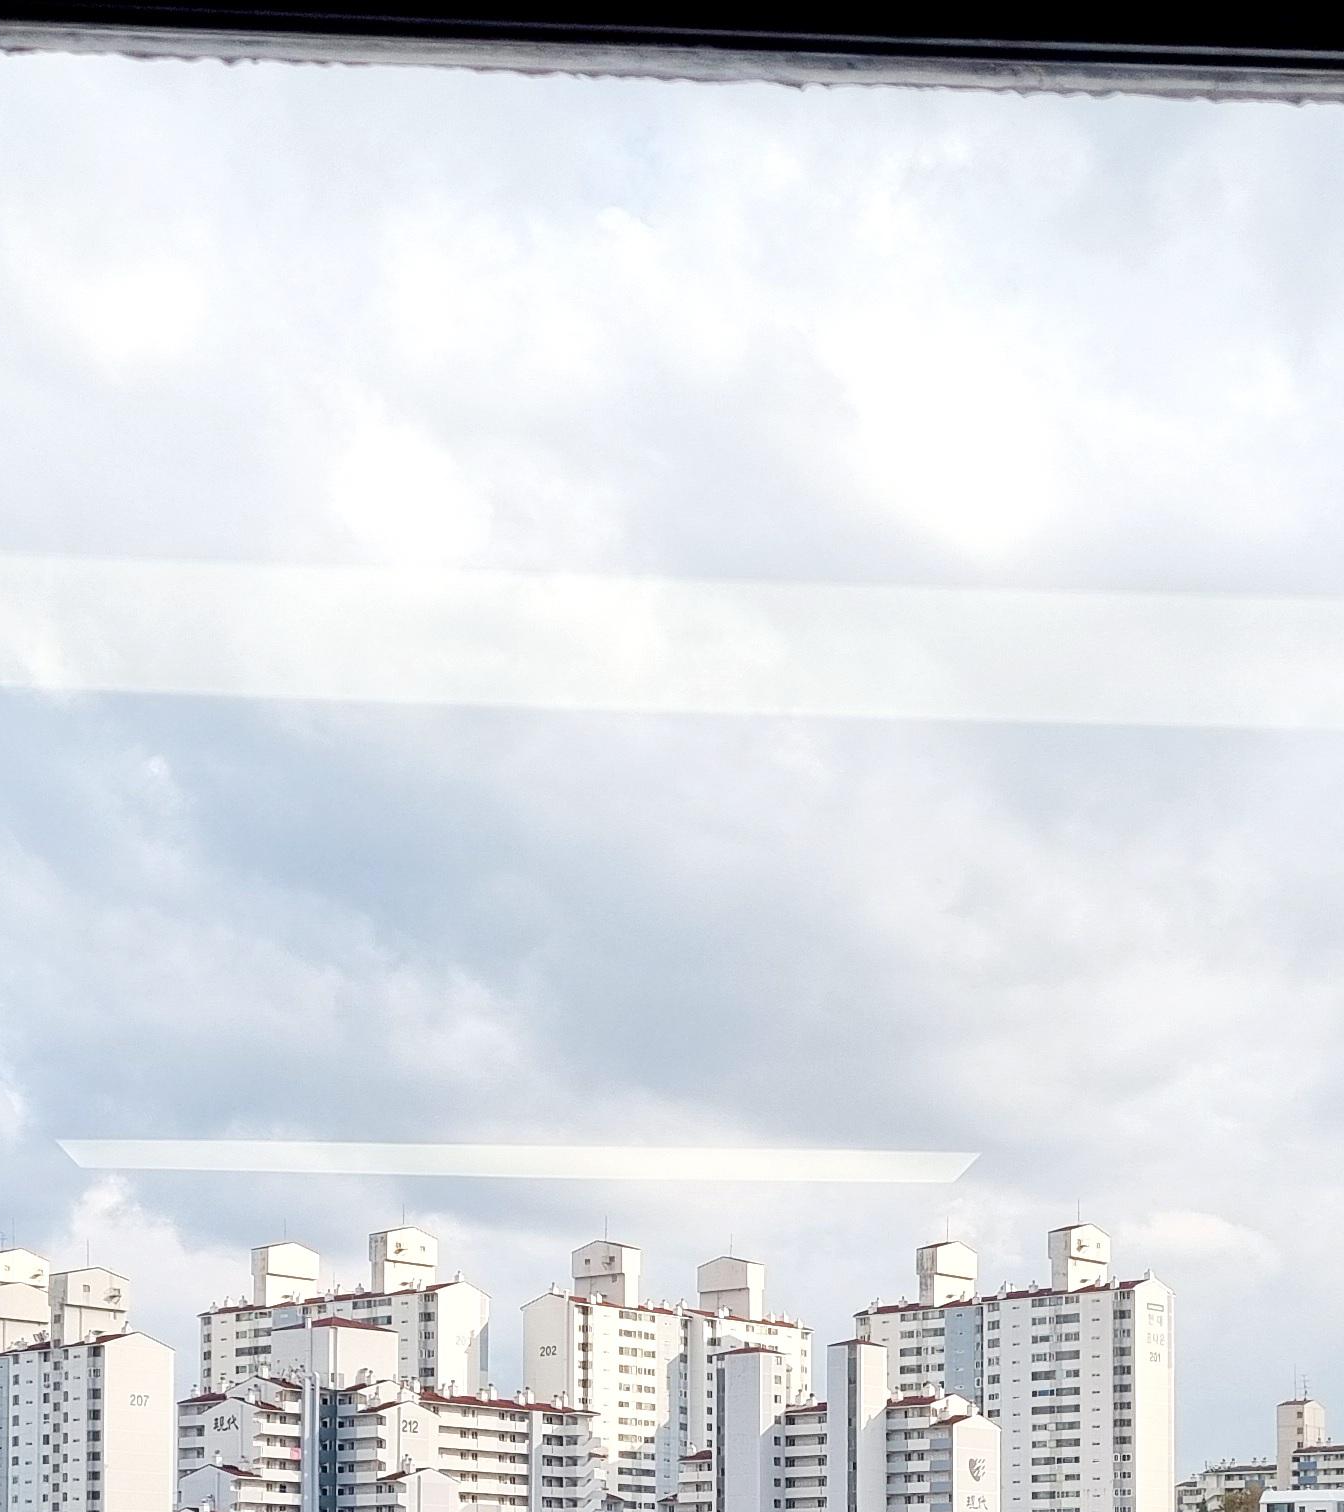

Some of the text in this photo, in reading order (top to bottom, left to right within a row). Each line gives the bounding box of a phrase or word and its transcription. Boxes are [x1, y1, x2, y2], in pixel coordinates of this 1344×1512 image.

[539, 1345, 557, 1356] 202
[129, 1394, 150, 1407] 207
[402, 1420, 419, 1433] 212
